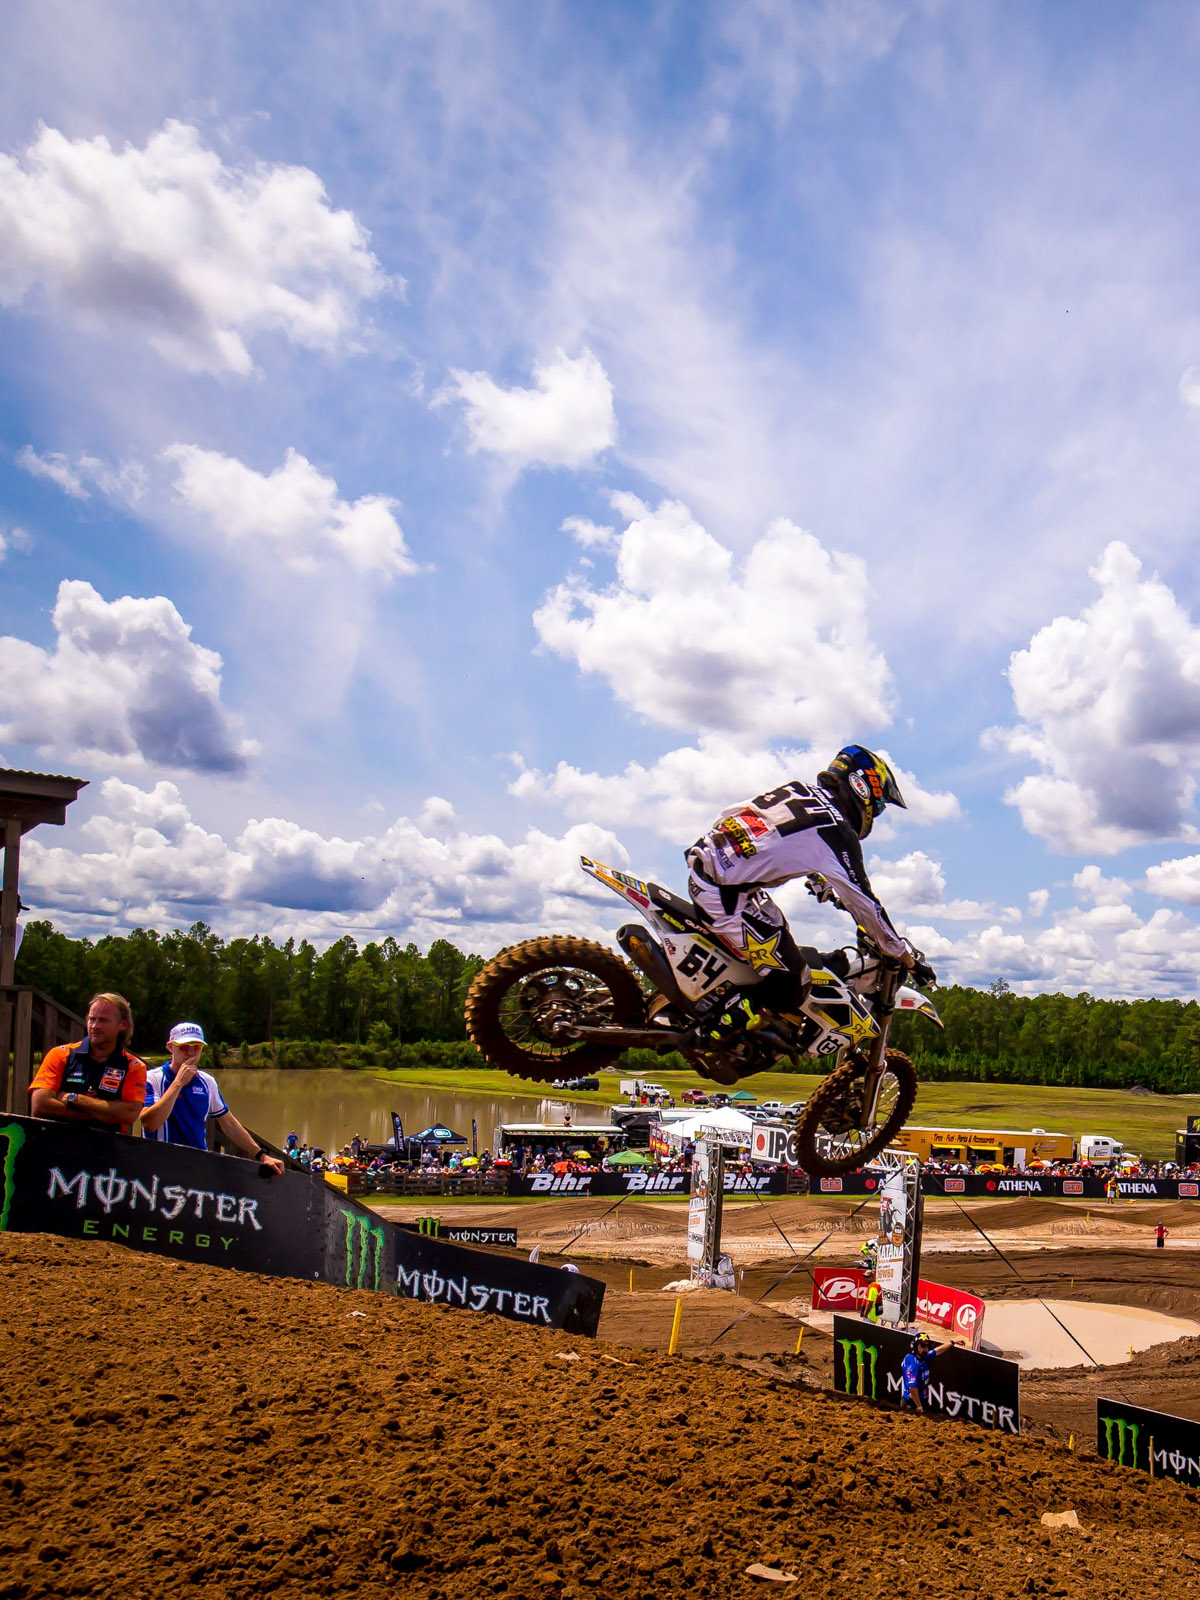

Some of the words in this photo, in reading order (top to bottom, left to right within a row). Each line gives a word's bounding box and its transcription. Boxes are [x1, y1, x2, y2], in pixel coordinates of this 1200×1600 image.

[752, 781, 837, 837] 64
[676, 943, 728, 990] 64
[527, 1173, 592, 1191] Bihr
[622, 1172, 684, 1190] Bihr
[723, 1172, 771, 1190] Bihr
[946, 1182, 964, 1190] GET
[998, 1180, 1042, 1192] ATHENA
[1065, 1184, 1082, 1192] GET
[1118, 1183, 1158, 1194] ATHENA
[47, 1166, 263, 1231] MONSTER
[83, 1219, 233, 1250] ENERGY
[449, 1230, 516, 1243] MONSTER
[396, 1264, 552, 1323] MONSTER
[883, 1290, 900, 1303] PONE
[886, 1371, 1019, 1435] MNSTER
